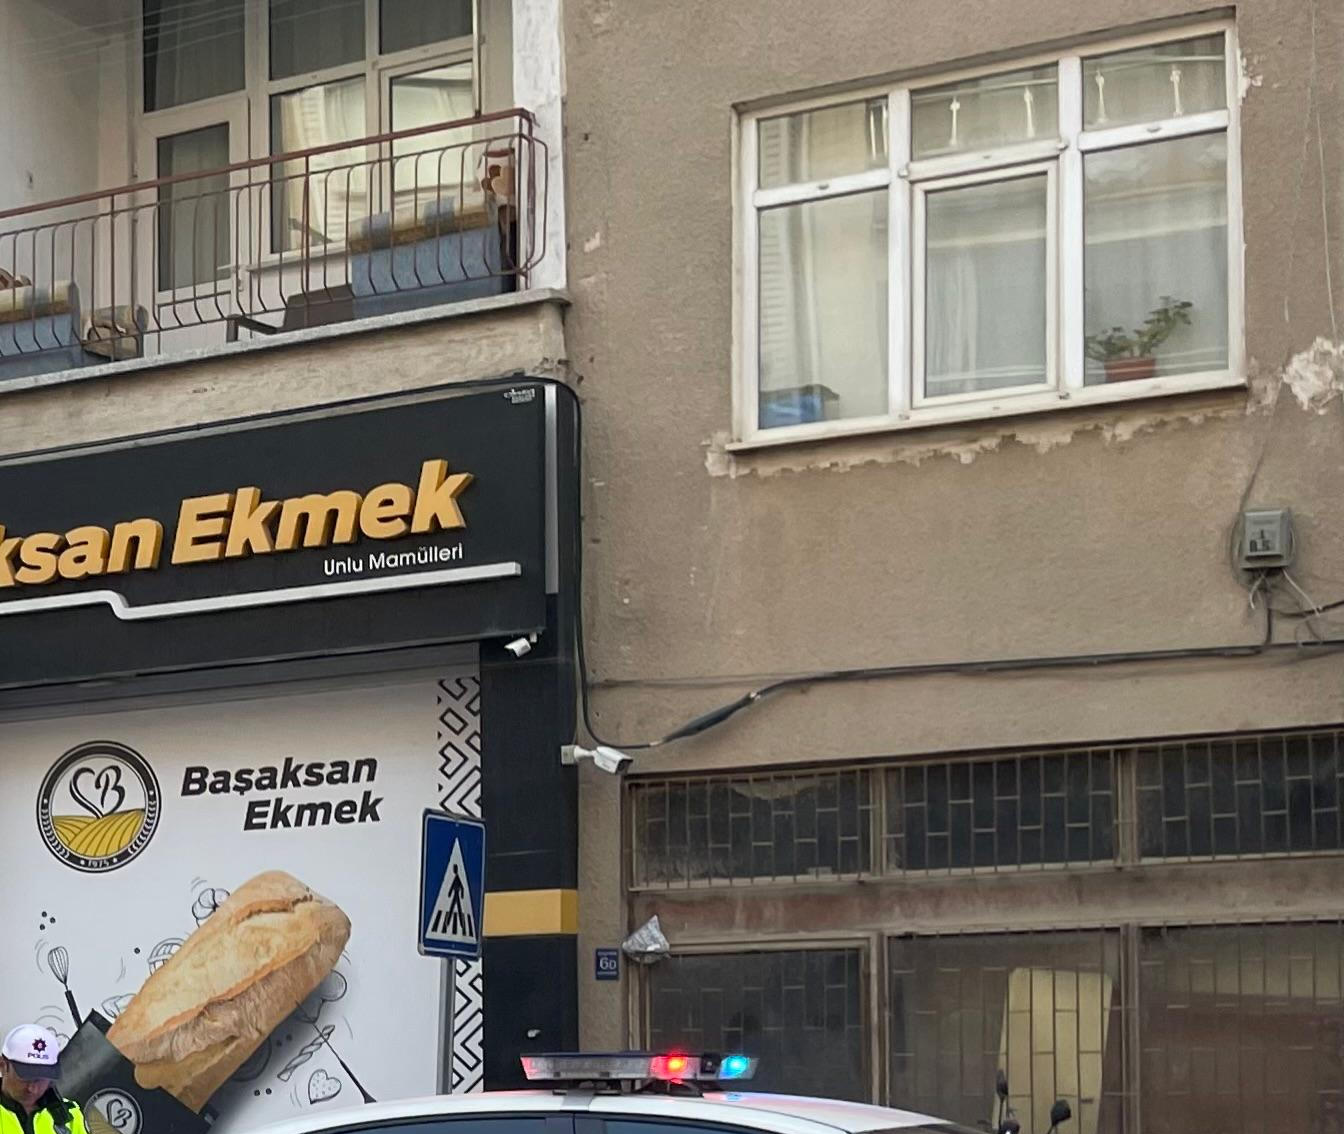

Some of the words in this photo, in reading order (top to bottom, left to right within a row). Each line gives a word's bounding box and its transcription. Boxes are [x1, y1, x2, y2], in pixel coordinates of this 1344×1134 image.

[172, 459, 474, 564] Ekmek
[324, 558, 363, 576] Unlu
[369, 542, 463, 570] Mamülleri
[181, 757, 378, 796] Başaksan
[244, 790, 384, 831] Ekmek
